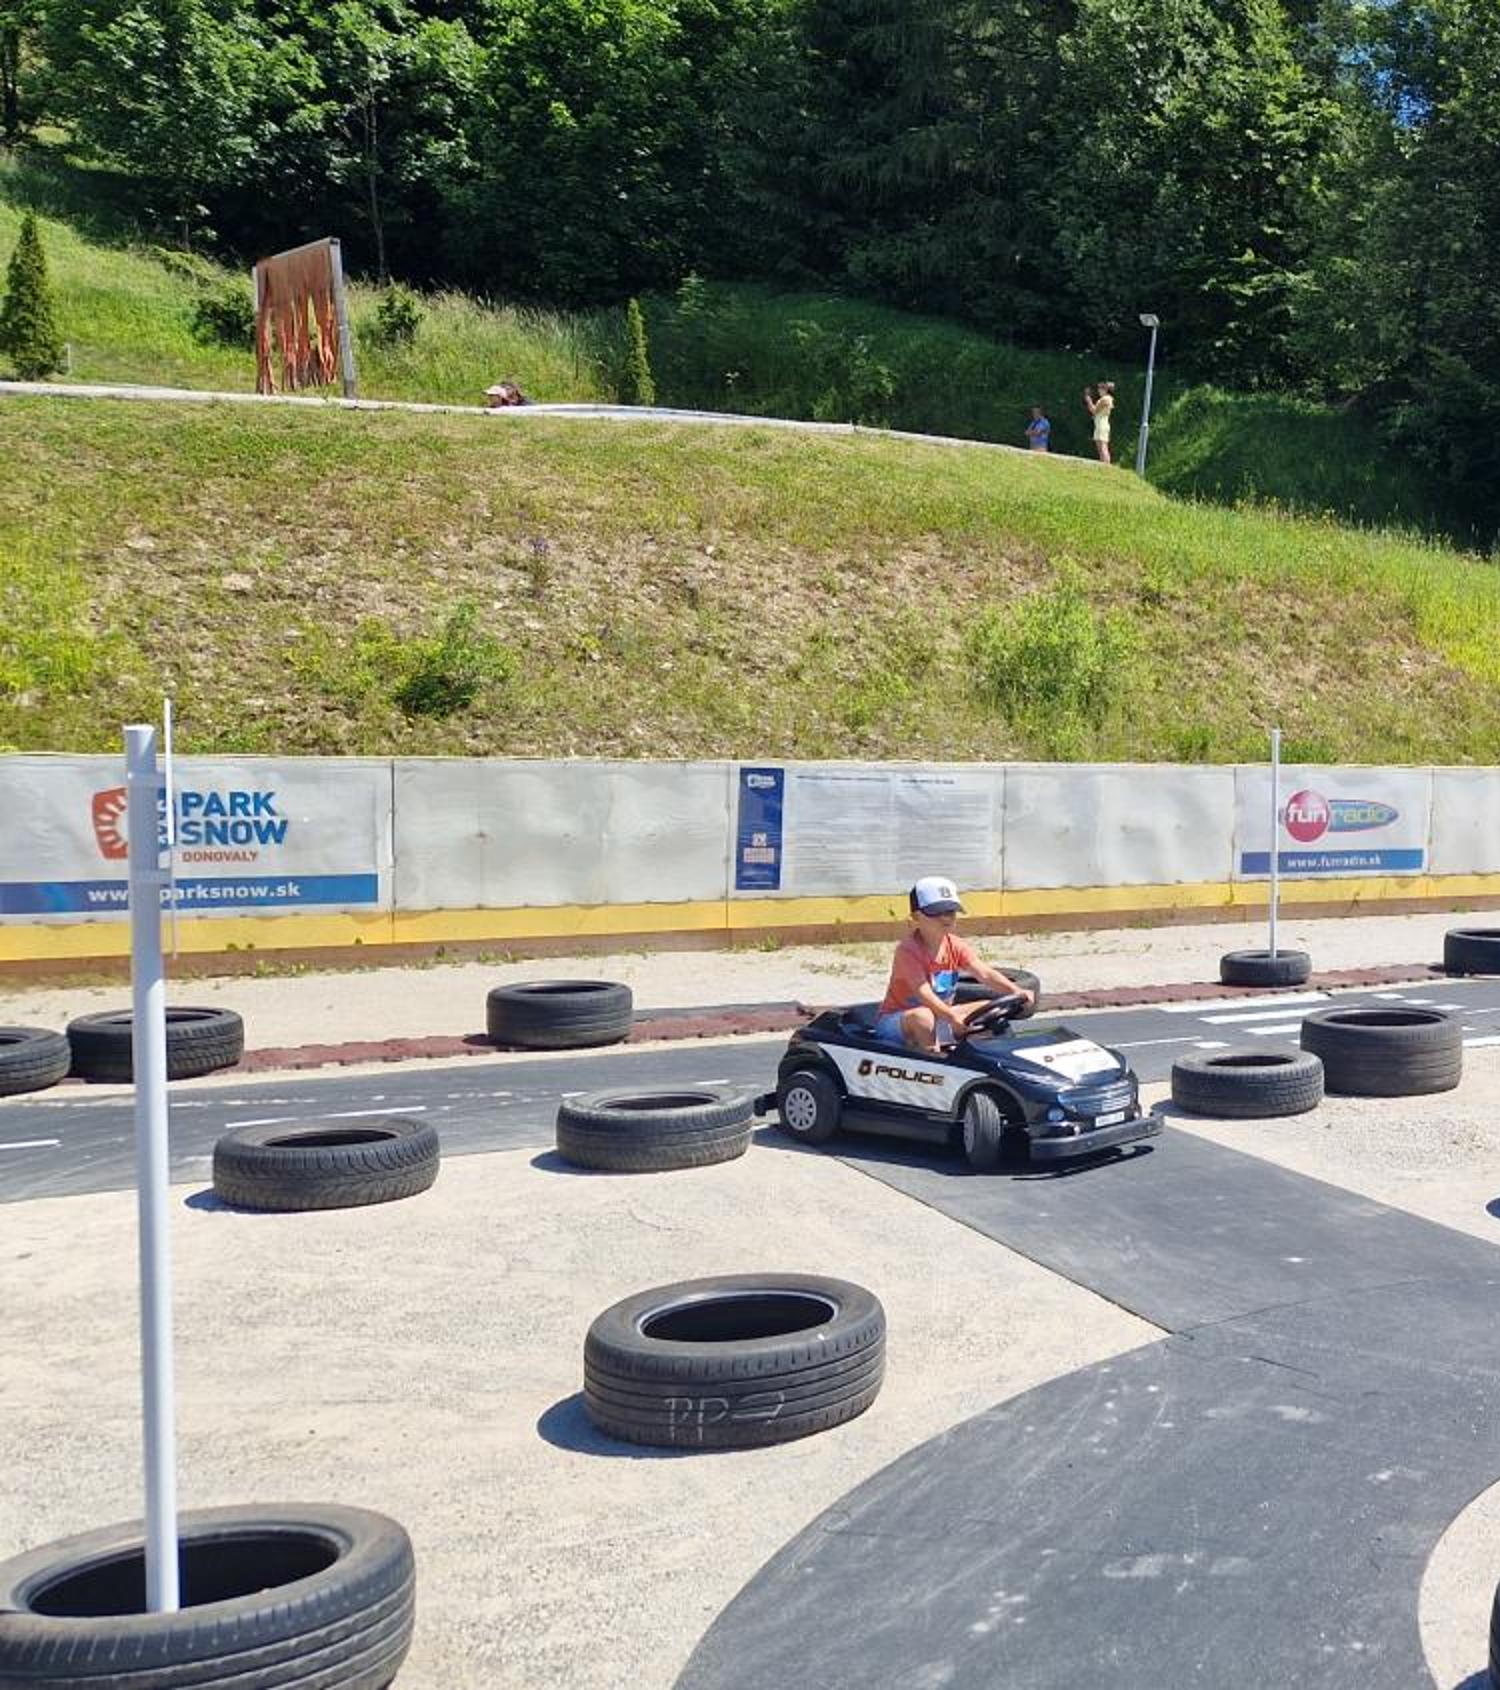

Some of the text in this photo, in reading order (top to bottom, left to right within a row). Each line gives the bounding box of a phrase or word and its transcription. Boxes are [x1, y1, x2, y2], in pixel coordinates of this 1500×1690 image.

[181, 791, 278, 817] PARK
[1287, 803, 1327, 823] fun
[180, 819, 288, 845] SNOW
[181, 850, 258, 862] DONOVALY
[87, 881, 301, 905] wwparksnow.sk
[875, 1065, 945, 1086] POLICE
